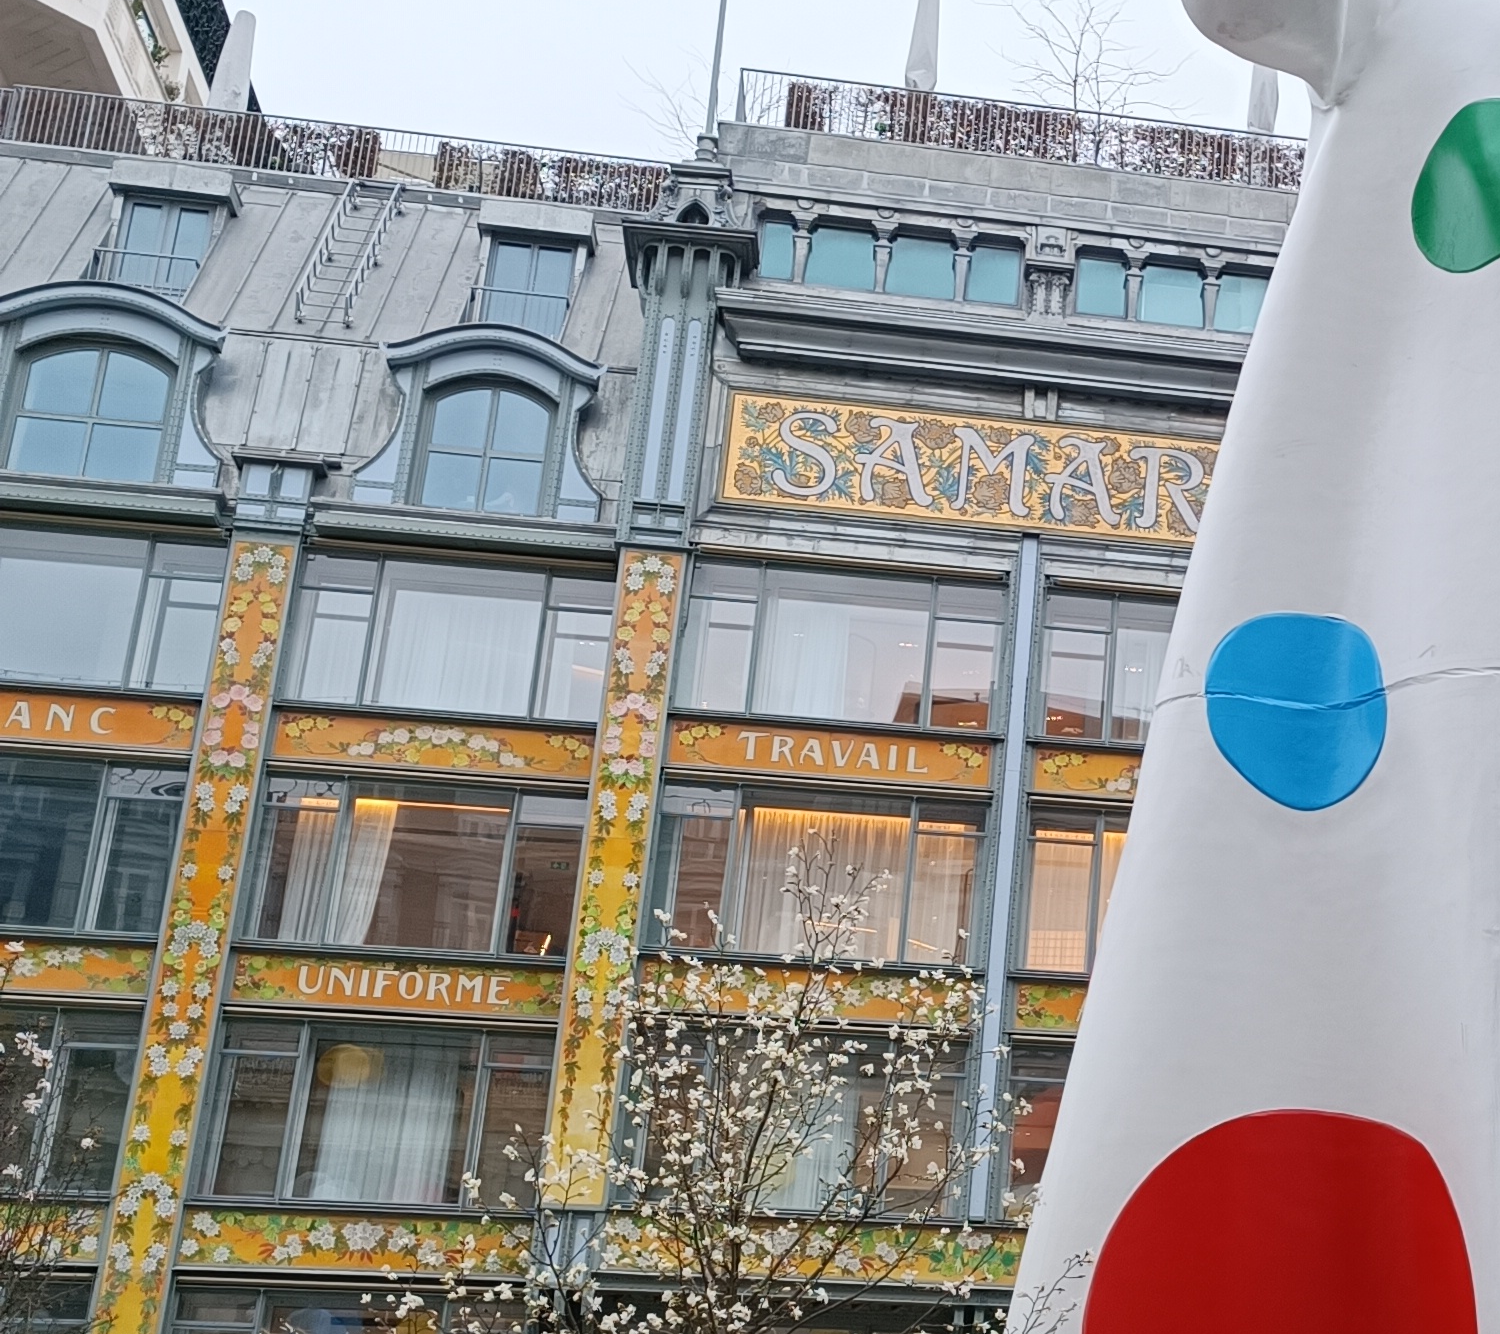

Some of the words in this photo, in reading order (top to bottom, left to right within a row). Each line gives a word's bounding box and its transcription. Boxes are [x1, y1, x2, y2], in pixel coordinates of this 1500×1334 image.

[771, 411, 1205, 532] SAMAR
[4, 700, 117, 735] ANC
[737, 730, 928, 774] TRAVAIL
[298, 965, 512, 1006] UNIFORME
